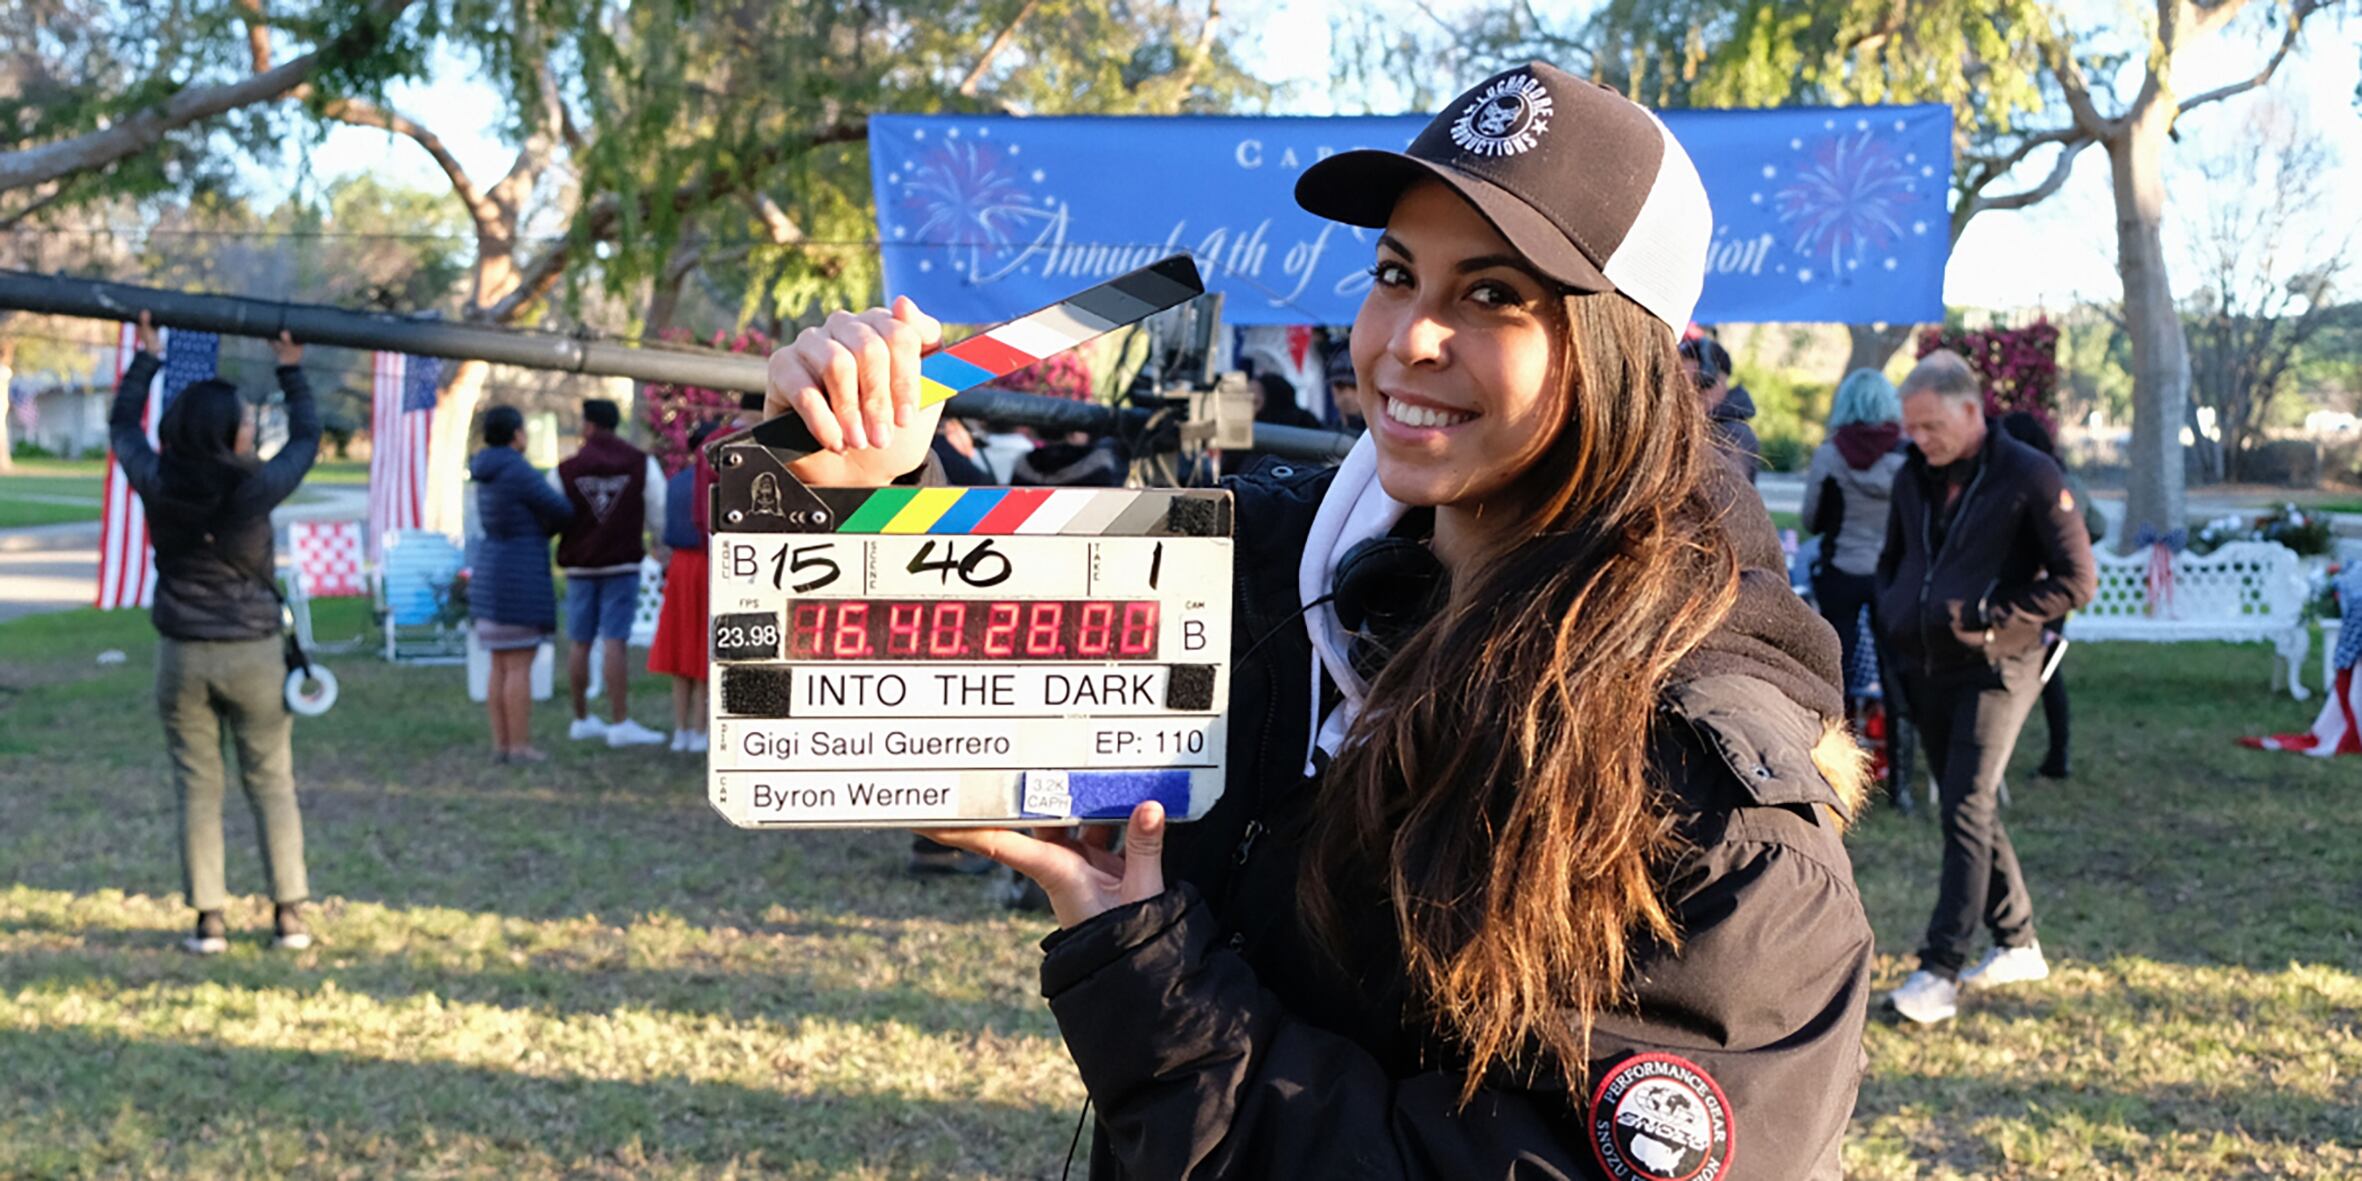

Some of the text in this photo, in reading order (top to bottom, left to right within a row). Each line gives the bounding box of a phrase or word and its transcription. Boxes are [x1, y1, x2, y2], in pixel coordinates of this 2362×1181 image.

[1193, 217, 1270, 286] 4th
[1268, 222, 1336, 307] of
[734, 545, 757, 576] B
[771, 542, 841, 593] 15
[906, 540, 1012, 588] 46
[1149, 541, 1163, 590] 1
[717, 625, 777, 648] 23.98
[1184, 620, 1206, 650] B
[808, 674, 1155, 706] INTO THE DARK
[744, 731, 1010, 760] Gigi Saul Guerrero
[1096, 729, 1203, 754] EP: 110
[754, 782, 950, 811] Byron Werner
[1604, 1061, 1709, 1104] PERFORMANCE
[1705, 1095, 1726, 1142] GEAR
[1596, 1120, 1628, 1176] SNOZU
